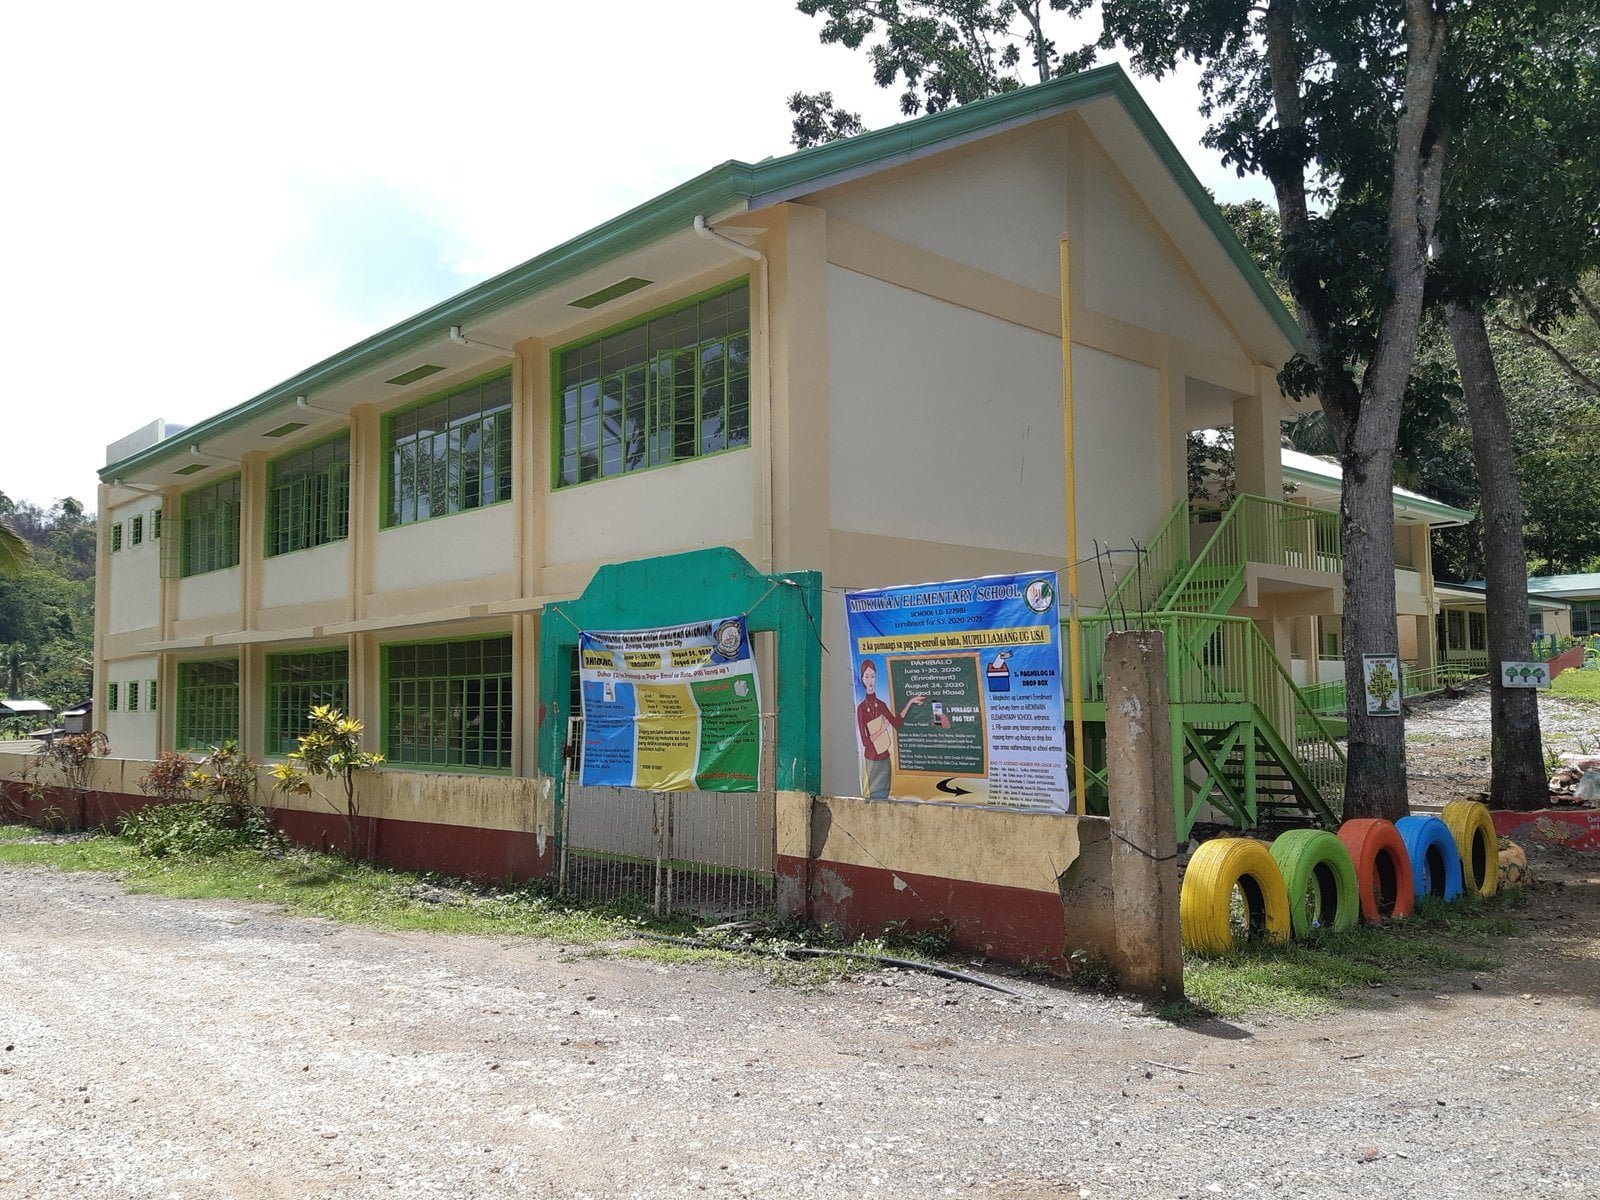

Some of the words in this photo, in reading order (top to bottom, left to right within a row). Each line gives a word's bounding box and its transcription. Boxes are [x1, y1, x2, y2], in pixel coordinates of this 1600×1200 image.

[850, 596, 900, 612] MIDKIWAN
[902, 587, 975, 607] ELEMENTARY
[977, 585, 1021, 601] SCHOOL
[895, 619, 925, 628] Enrollment
[927, 617, 935, 626] for
[674, 639, 683, 648] City
[863, 643, 866, 651] 2
[867, 641, 874, 650] ka
[897, 640, 903, 648] sa
[904, 640, 914, 651] pag
[947, 635, 961, 646] bata,
[962, 634, 986, 646] MUPILI
[988, 632, 1017, 643] LAMANG
[1019, 631, 1030, 642] UG
[1031, 630, 1045, 640] USA
[1022, 679, 1036, 687] DROP
